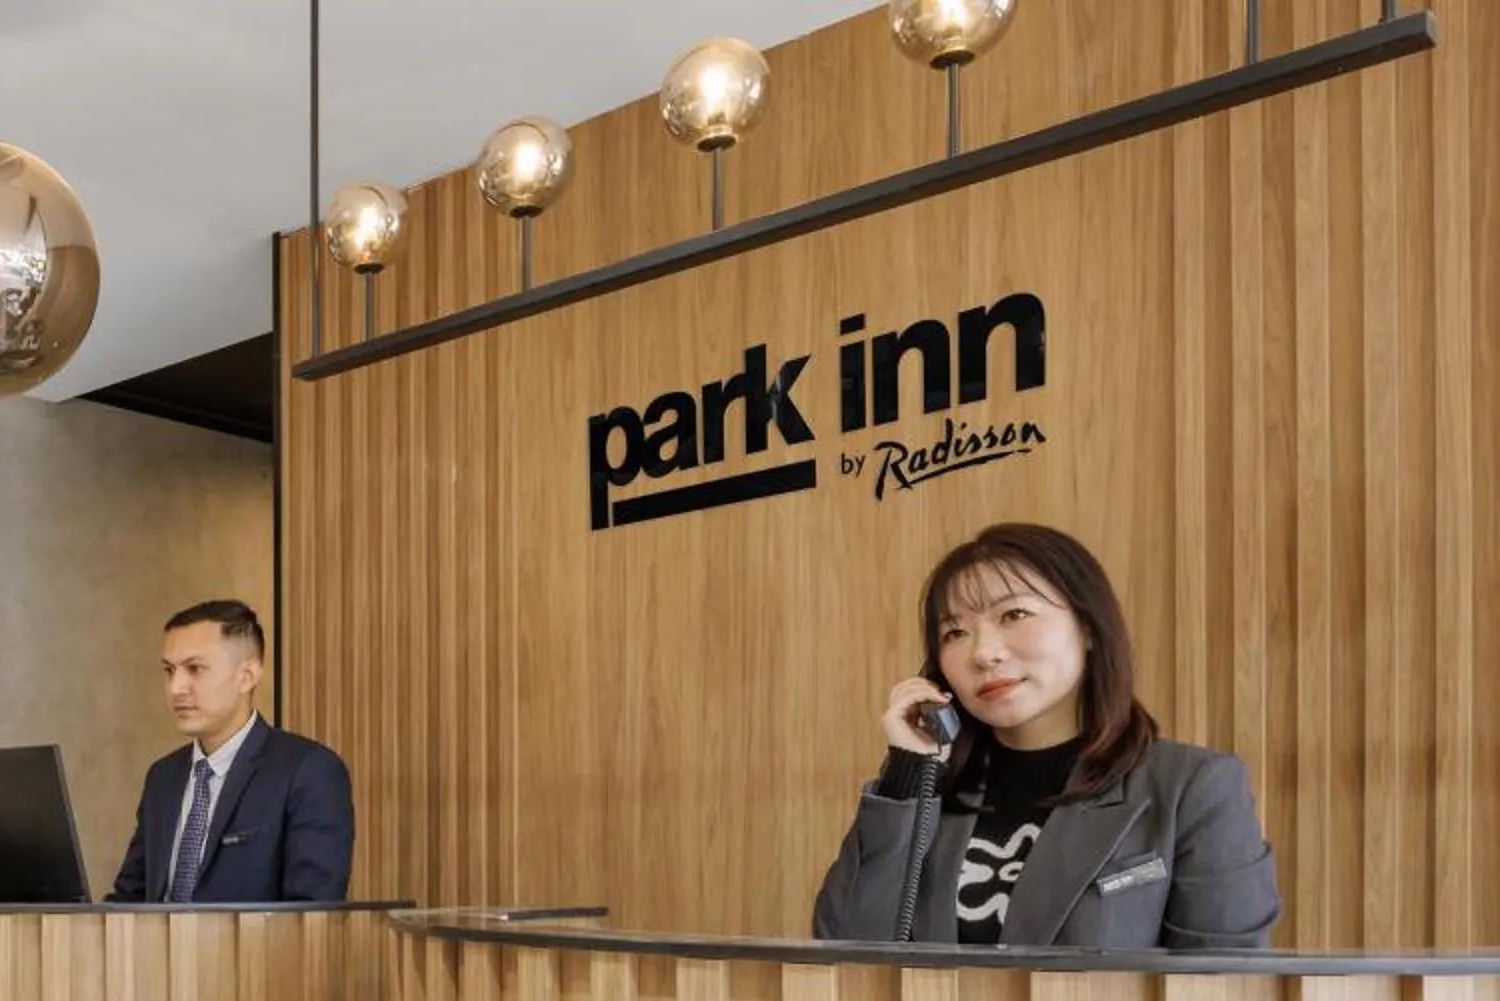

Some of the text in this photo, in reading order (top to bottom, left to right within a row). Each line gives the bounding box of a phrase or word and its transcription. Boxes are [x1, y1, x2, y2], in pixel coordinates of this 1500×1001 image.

[588, 292, 1046, 531] park inn
[841, 417, 1047, 500] by Radisson
